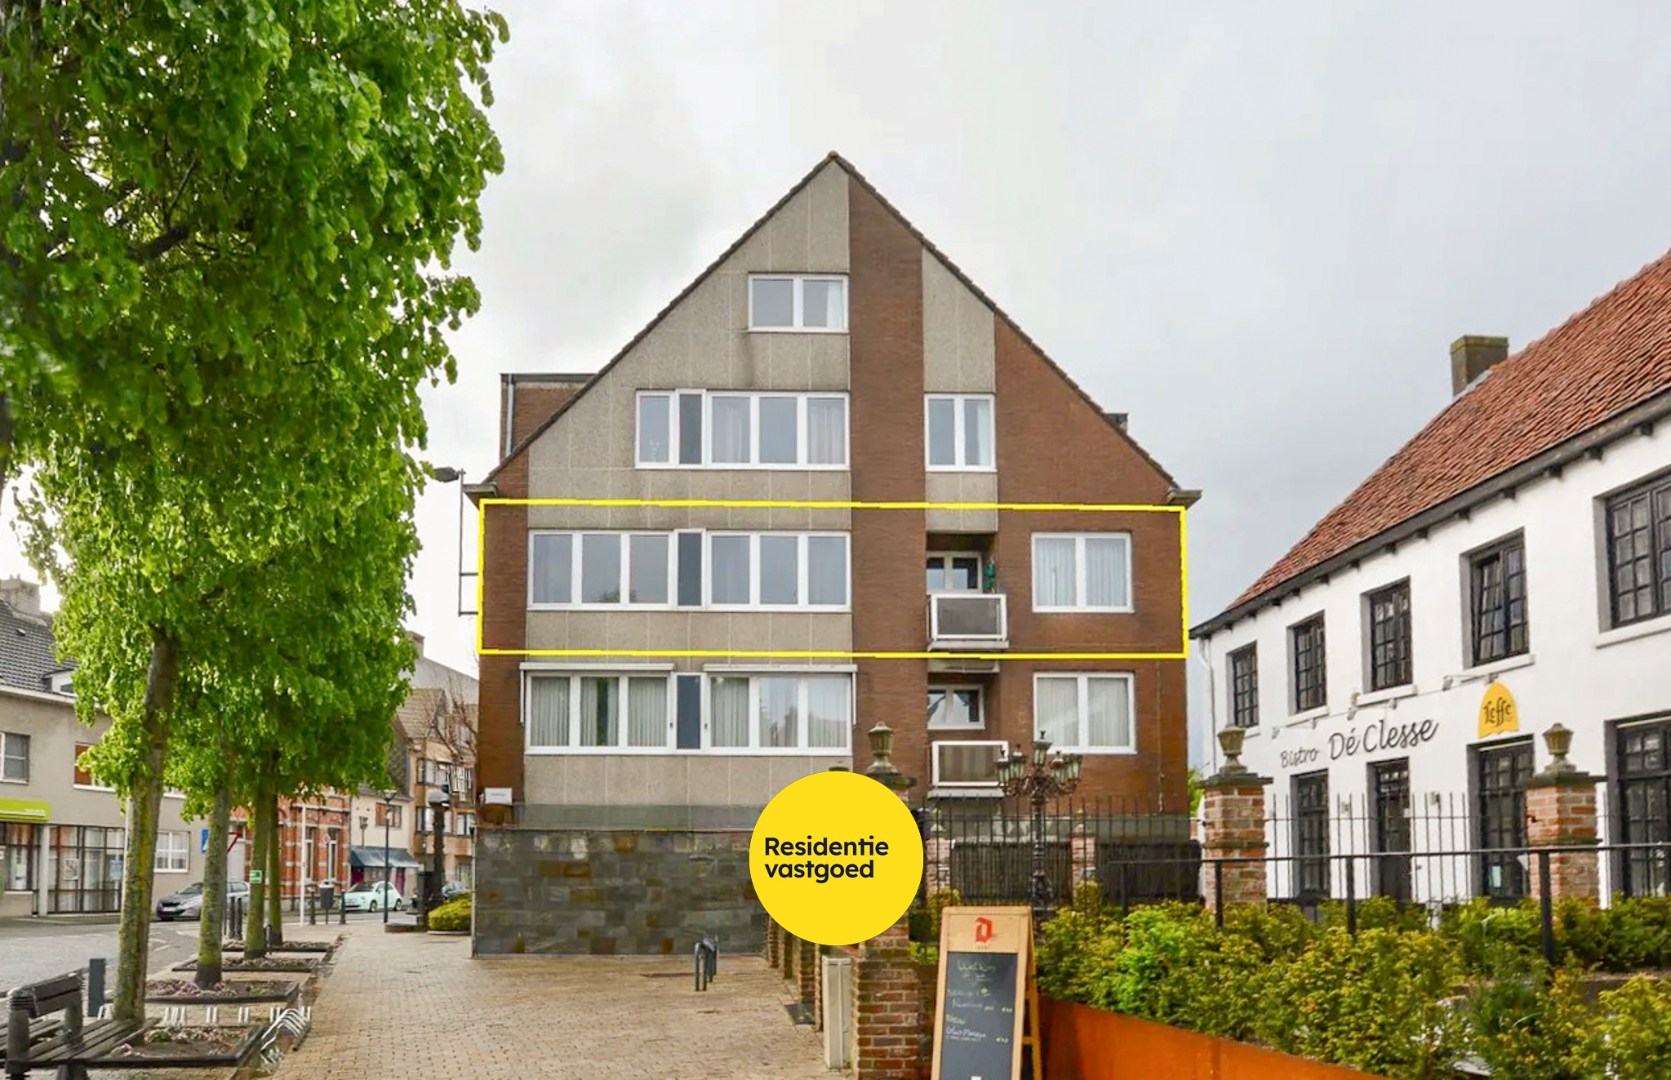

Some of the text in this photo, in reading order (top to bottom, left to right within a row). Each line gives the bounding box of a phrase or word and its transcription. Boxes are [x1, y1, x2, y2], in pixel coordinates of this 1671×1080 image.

[1483, 697, 1512, 728] Leffe
[1280, 719, 1439, 768] Bistro Dé Clesse
